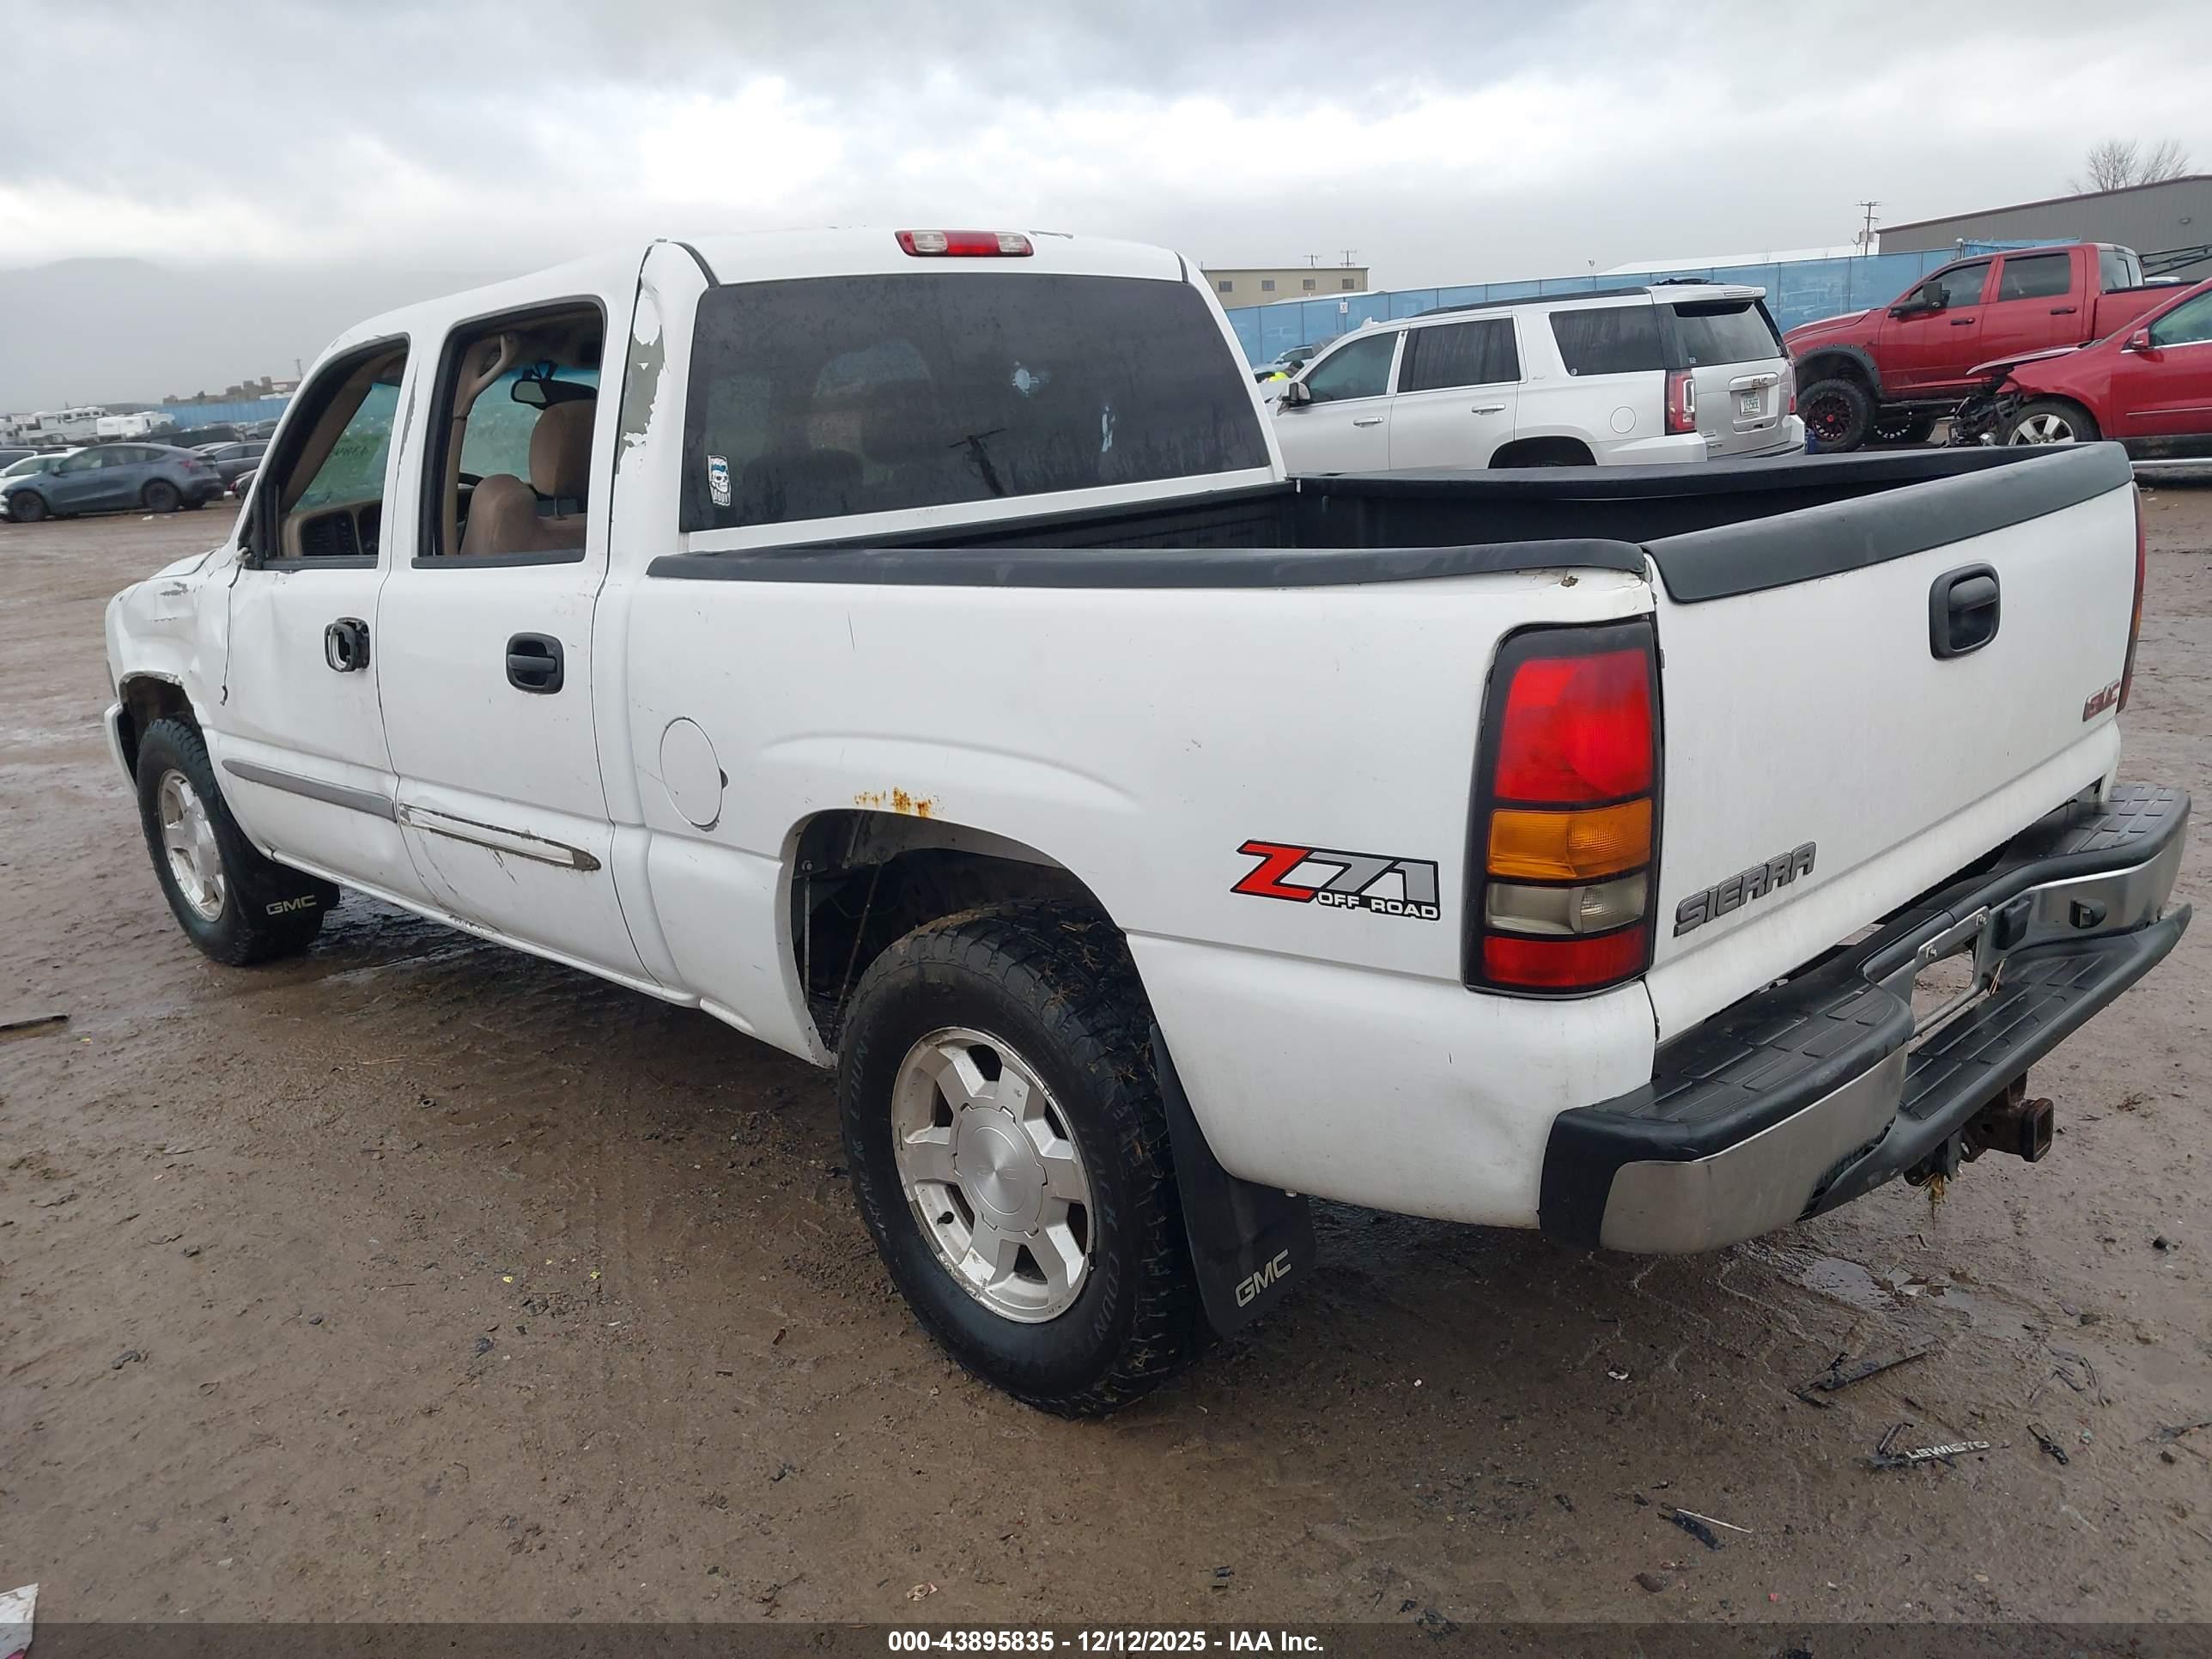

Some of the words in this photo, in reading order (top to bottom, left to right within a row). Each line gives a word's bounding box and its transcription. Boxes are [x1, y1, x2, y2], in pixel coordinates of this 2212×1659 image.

[2082, 678, 2121, 722] GMC
[1230, 839, 1439, 904] Z71
[1674, 840, 1817, 938] SIERRA
[265, 895, 317, 915] GMC
[1317, 891, 1360, 908] OFF
[1370, 897, 1439, 920] ROAD
[1235, 1248, 1291, 1307] GMC
